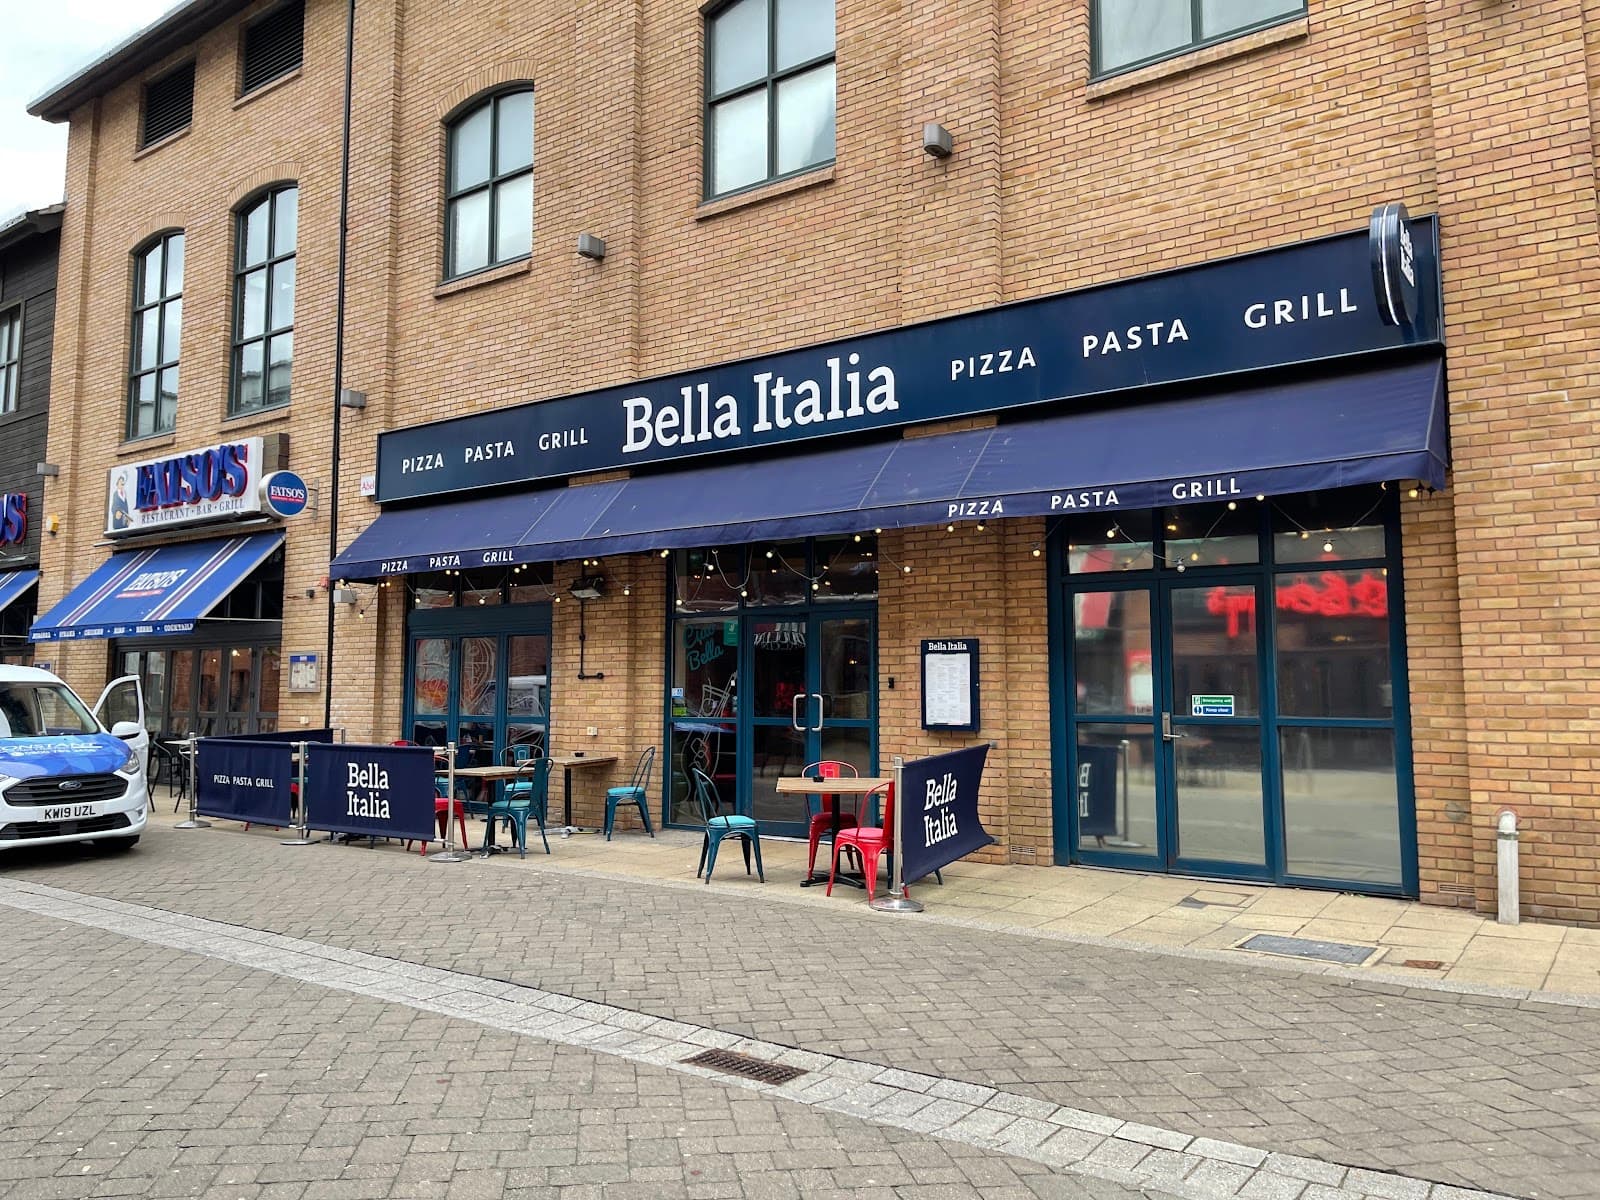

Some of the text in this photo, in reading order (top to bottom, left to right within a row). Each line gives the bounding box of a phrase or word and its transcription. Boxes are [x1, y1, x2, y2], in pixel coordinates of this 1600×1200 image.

[952, 288, 1357, 380] PIZZA PASTA GRILL
[622, 352, 898, 453] Bella Italia
[402, 428, 588, 473] PIZZA PASTA GRILL
[142, 499, 243, 525] RESTAURANT BAR GRILL
[948, 478, 1241, 518] PIZZA PASTA GRILL
[381, 550, 513, 573] PIZZA PASTA GRILL
[687, 640, 725, 671] Bella
[928, 641, 967, 651] Bella Italia
[213, 774, 274, 788] PIZZA PASTA GRILL
[347, 762, 389, 789] Bella
[347, 791, 391, 819] Italia
[924, 772, 957, 810] Bella
[44, 805, 96, 820] KW19 UZL
[924, 809, 958, 847] Italia
